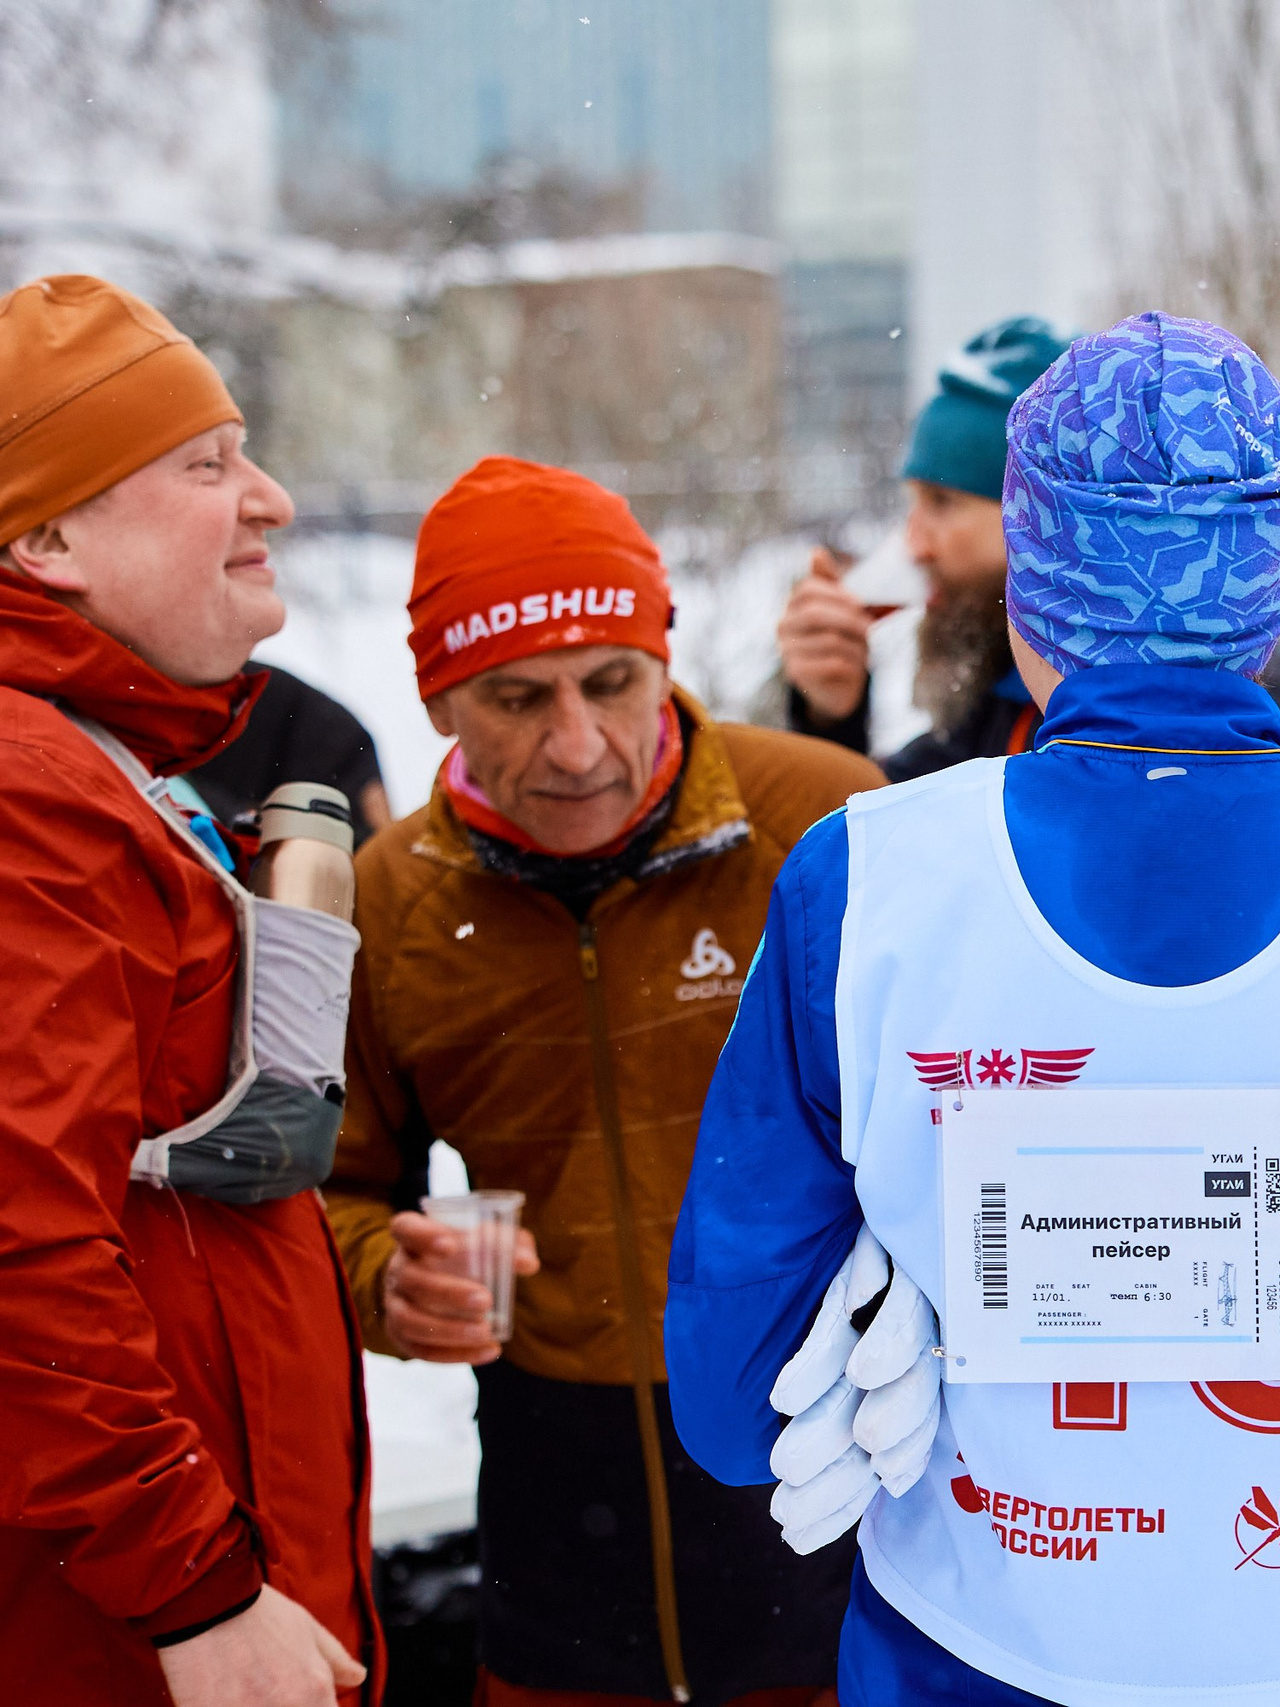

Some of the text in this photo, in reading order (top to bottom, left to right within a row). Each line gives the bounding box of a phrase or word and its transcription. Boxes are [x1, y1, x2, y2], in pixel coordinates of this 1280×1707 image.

[444, 587, 637, 654] MADSHUS
[1020, 1212, 1242, 1233] Административный
[973, 1212, 983, 1282] 1234567890
[1091, 1240, 1171, 1261] пейсер
[1110, 1292, 1138, 1301] темп
[1143, 1292, 1172, 1302] 6:30
[1266, 1284, 1278, 1311] 123456
[976, 1485, 1165, 1533] ВЕРТОЛЕТЫ
[992, 1522, 1098, 1561] ОССИИ
